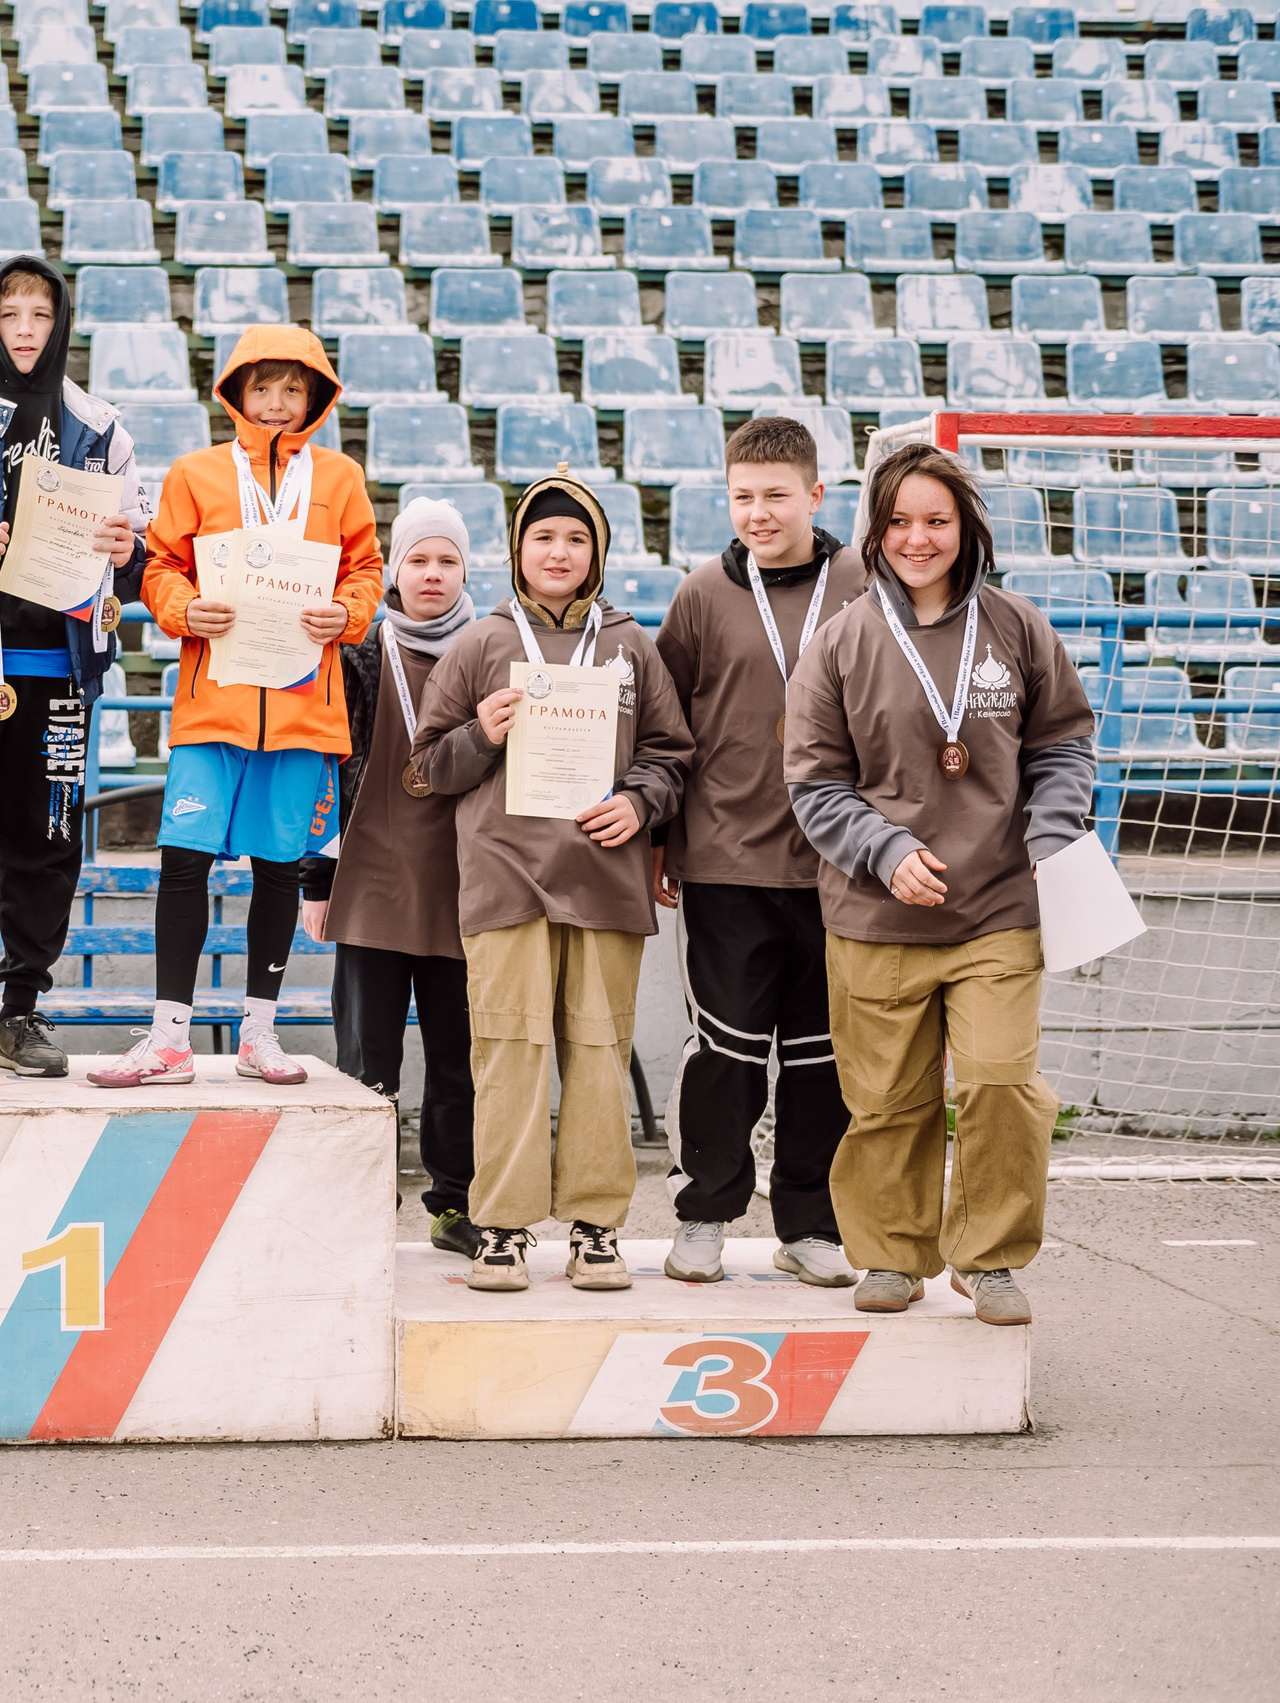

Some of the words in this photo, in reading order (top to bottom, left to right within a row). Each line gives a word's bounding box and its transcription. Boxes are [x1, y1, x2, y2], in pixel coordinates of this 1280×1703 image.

[37, 495, 108, 525] ГРАМОТА
[245, 574, 322, 597] ГРАМОТА
[529, 705, 607, 720] ГРАМОТА
[929, 693, 948, 725] Пасхальный
[953, 683, 966, 716] Пасхальный
[977, 710, 1012, 719] Кемерово
[21, 1221, 105, 1331] 1
[659, 1334, 779, 1435] 3
